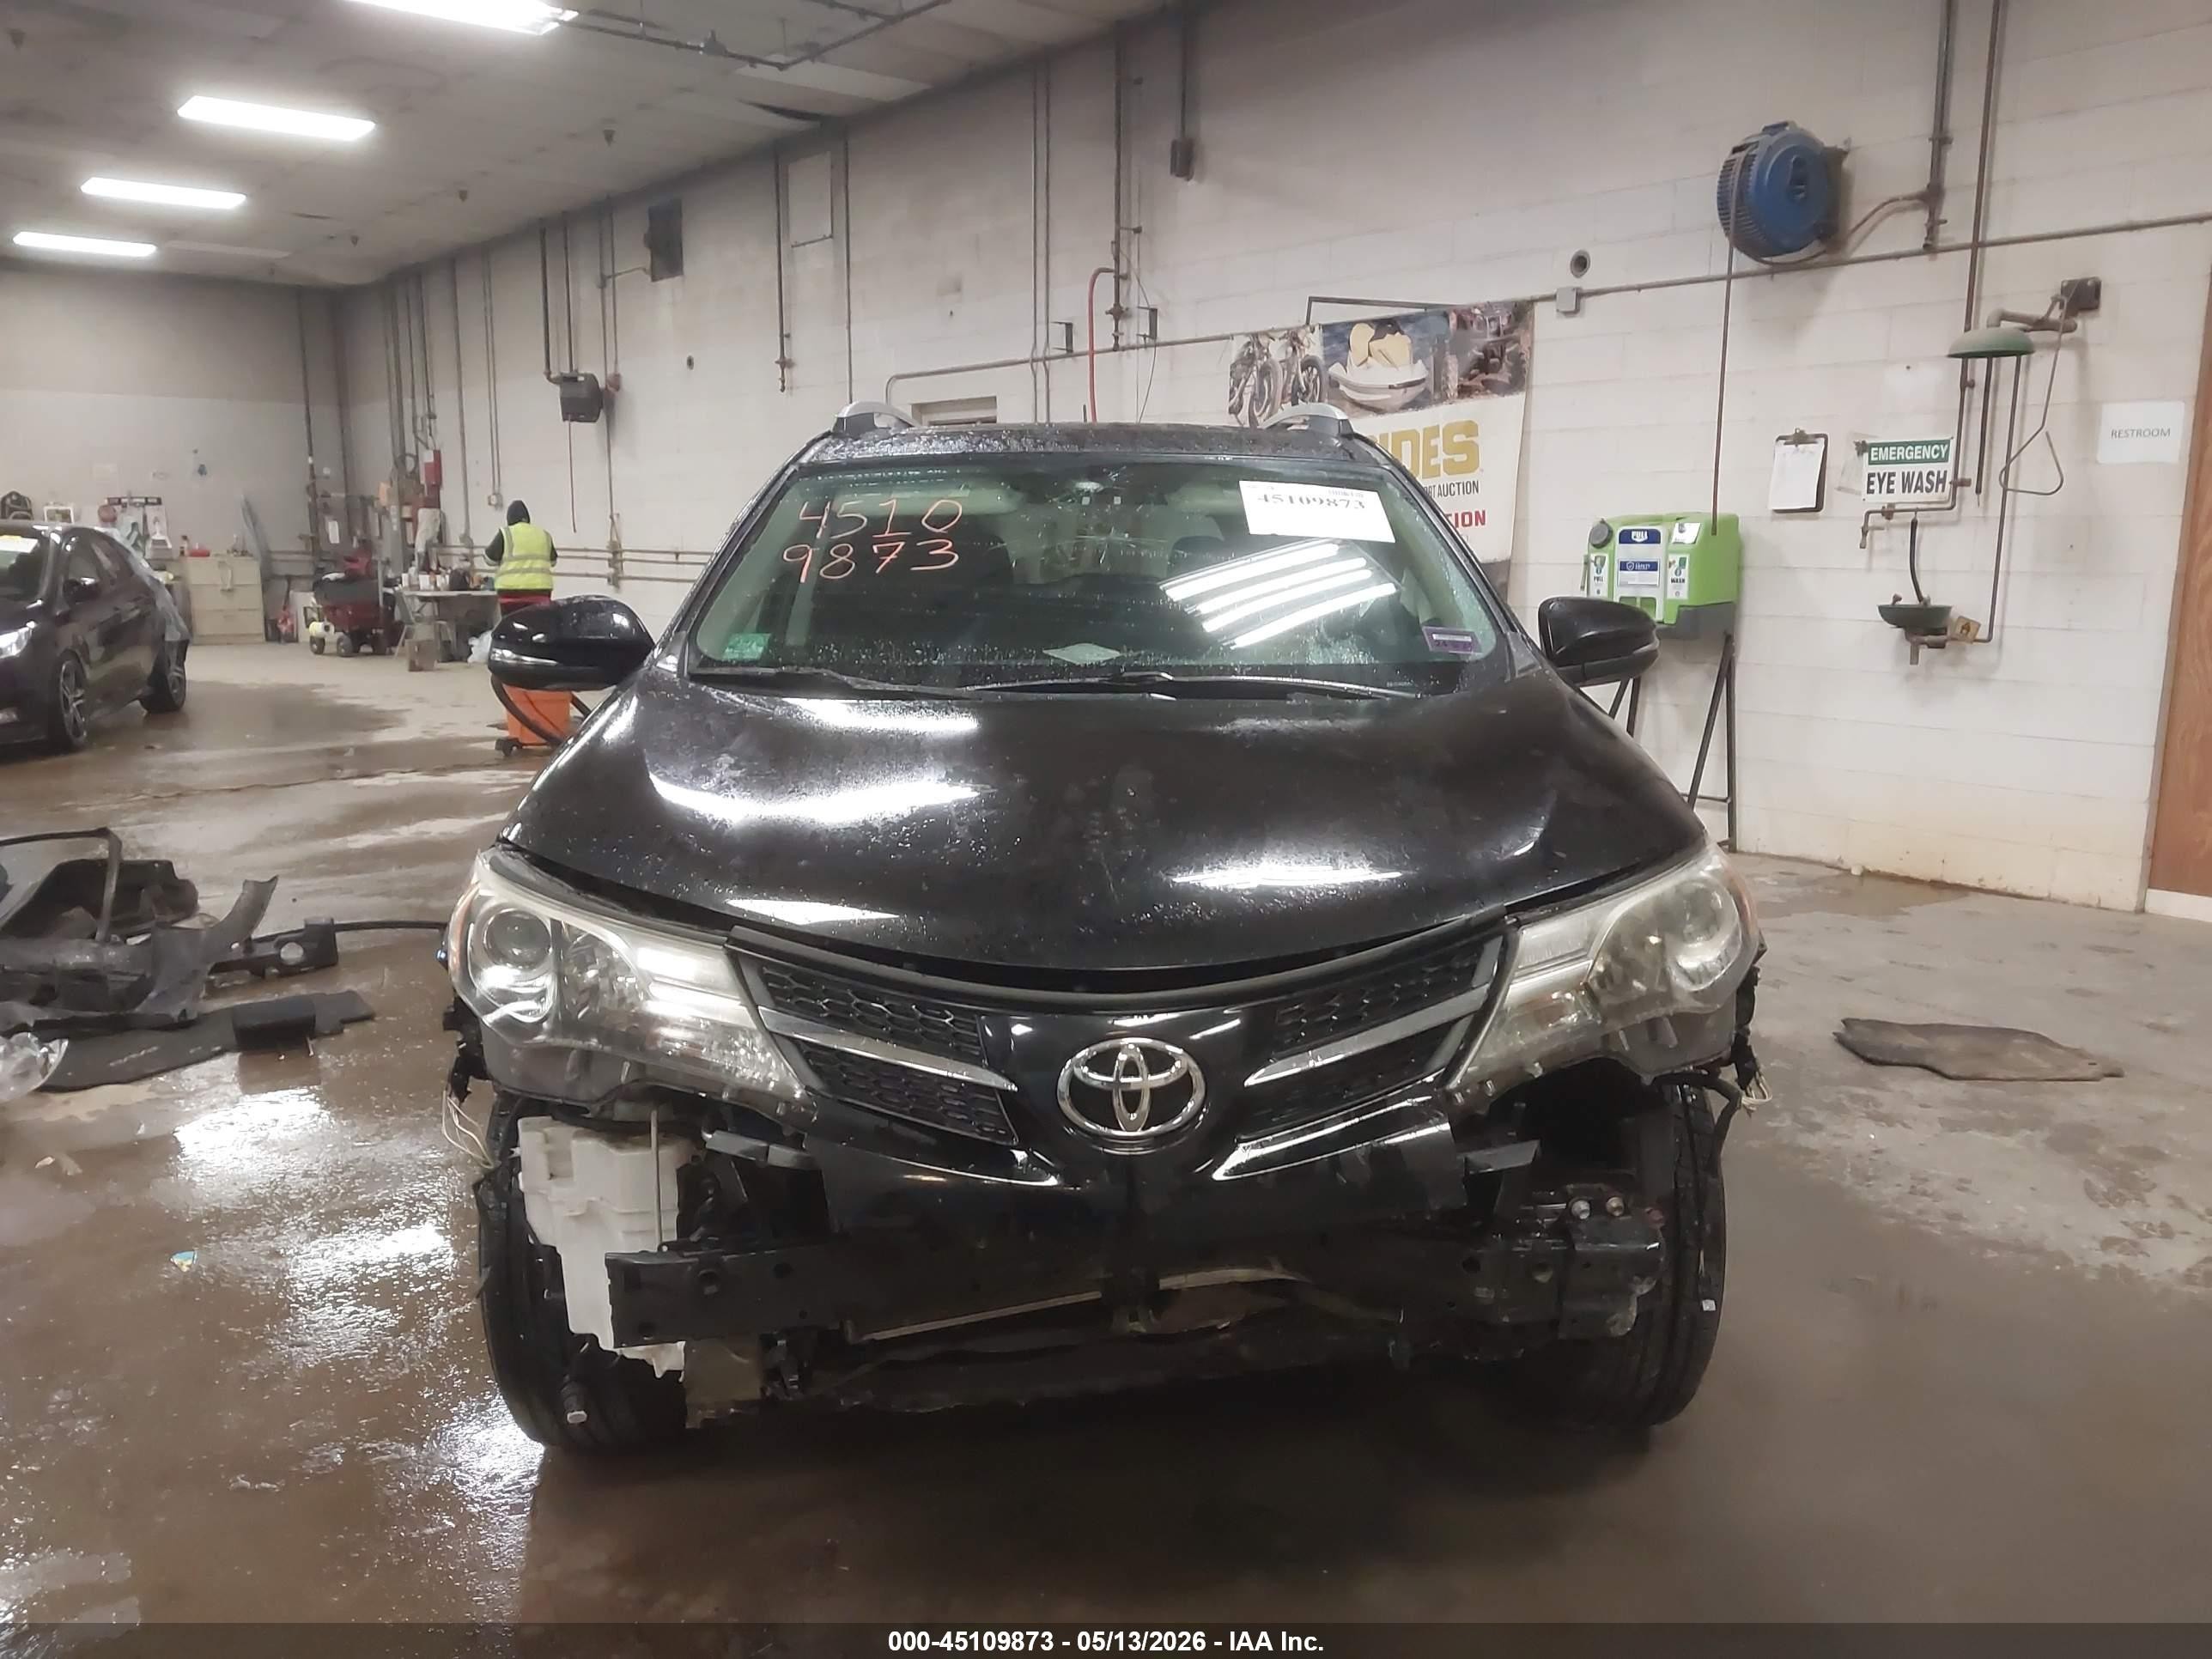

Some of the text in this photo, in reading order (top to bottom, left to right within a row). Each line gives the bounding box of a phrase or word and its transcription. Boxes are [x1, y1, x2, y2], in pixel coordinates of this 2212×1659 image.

[2111, 428, 2171, 439] RESTROOM
[1870, 444, 1948, 461] EMERGENCY
[1437, 480, 1480, 498] AUCTION
[1866, 470, 1948, 495] EYE WASH
[798, 499, 963, 539] 4510
[782, 539, 959, 583] 9873
